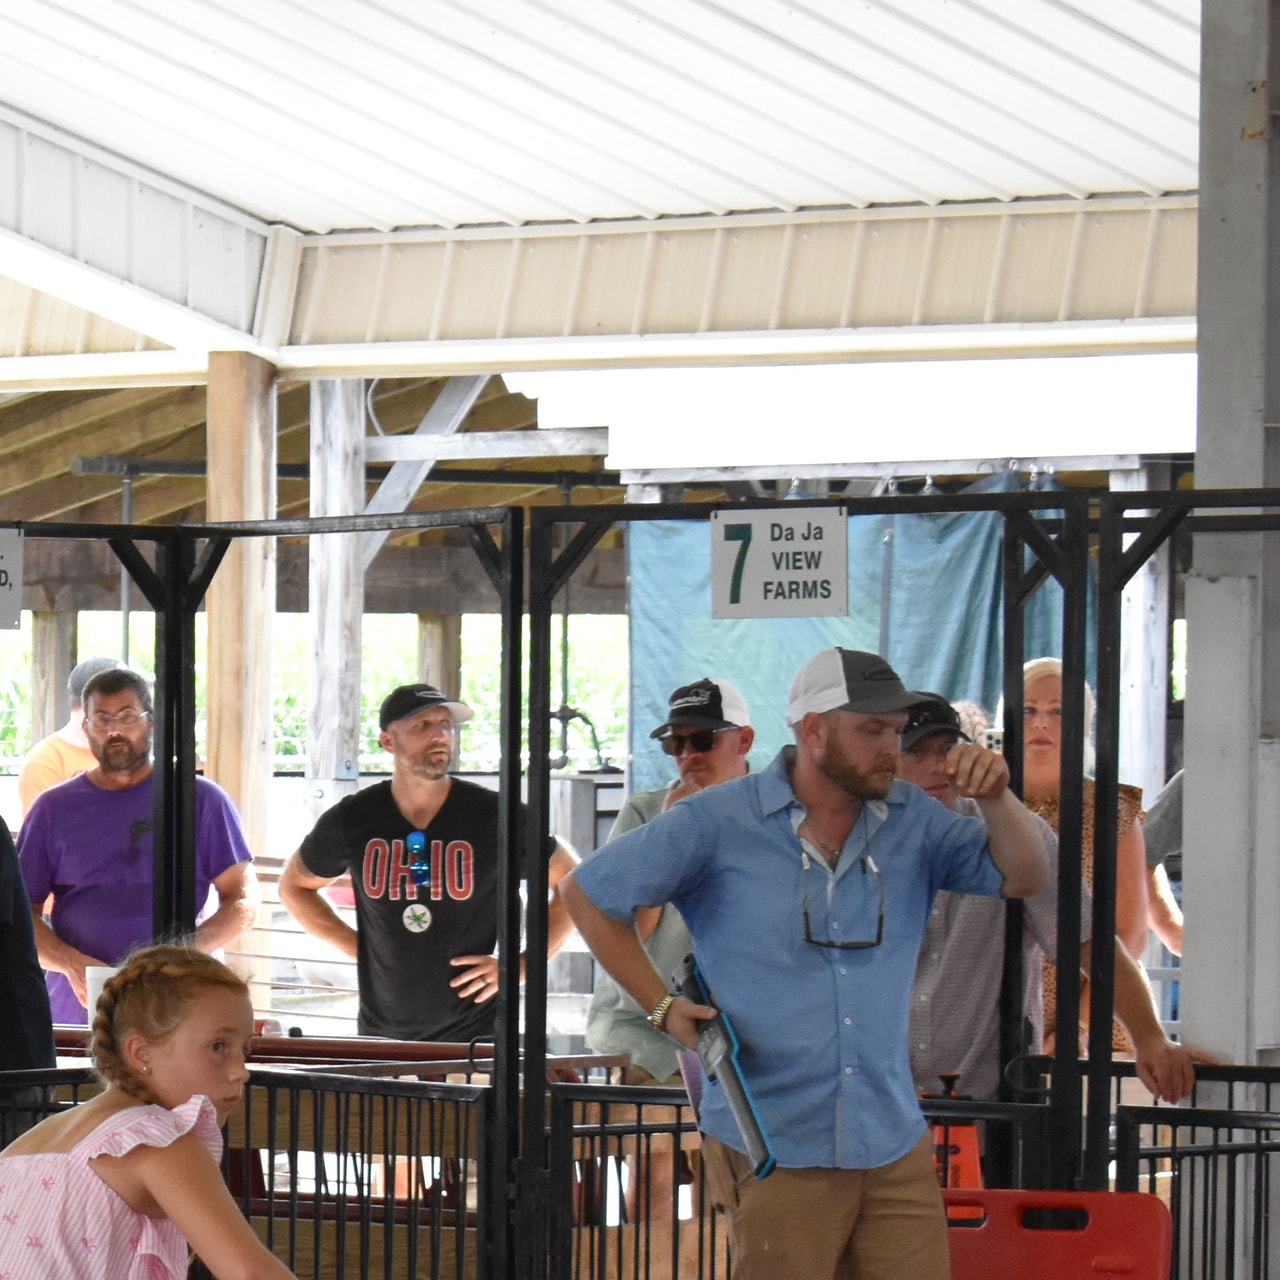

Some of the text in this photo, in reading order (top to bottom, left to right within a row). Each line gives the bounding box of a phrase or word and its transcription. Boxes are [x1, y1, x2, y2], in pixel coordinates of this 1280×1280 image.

[770, 521, 824, 541] Da Ja
[723, 523, 752, 604] 7
[771, 550, 822, 571] VIEW
[762, 579, 832, 600] FARMS
[361, 837, 474, 900] OHIO
